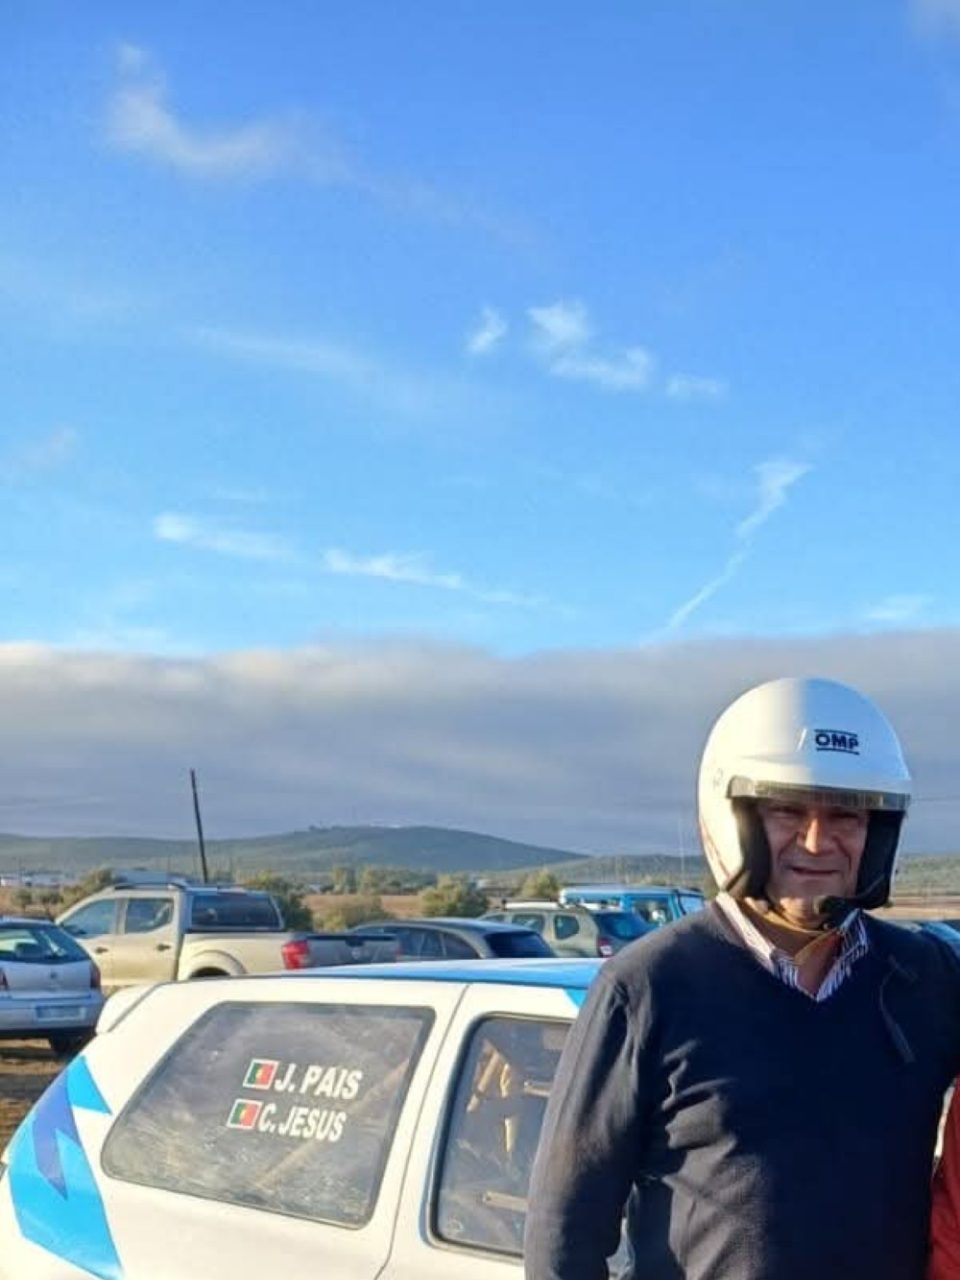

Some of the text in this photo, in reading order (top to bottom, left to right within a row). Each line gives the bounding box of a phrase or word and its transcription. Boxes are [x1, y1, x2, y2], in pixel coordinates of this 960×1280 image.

[815, 733, 859, 750] OMP
[274, 1063, 363, 1100] J. PAIS
